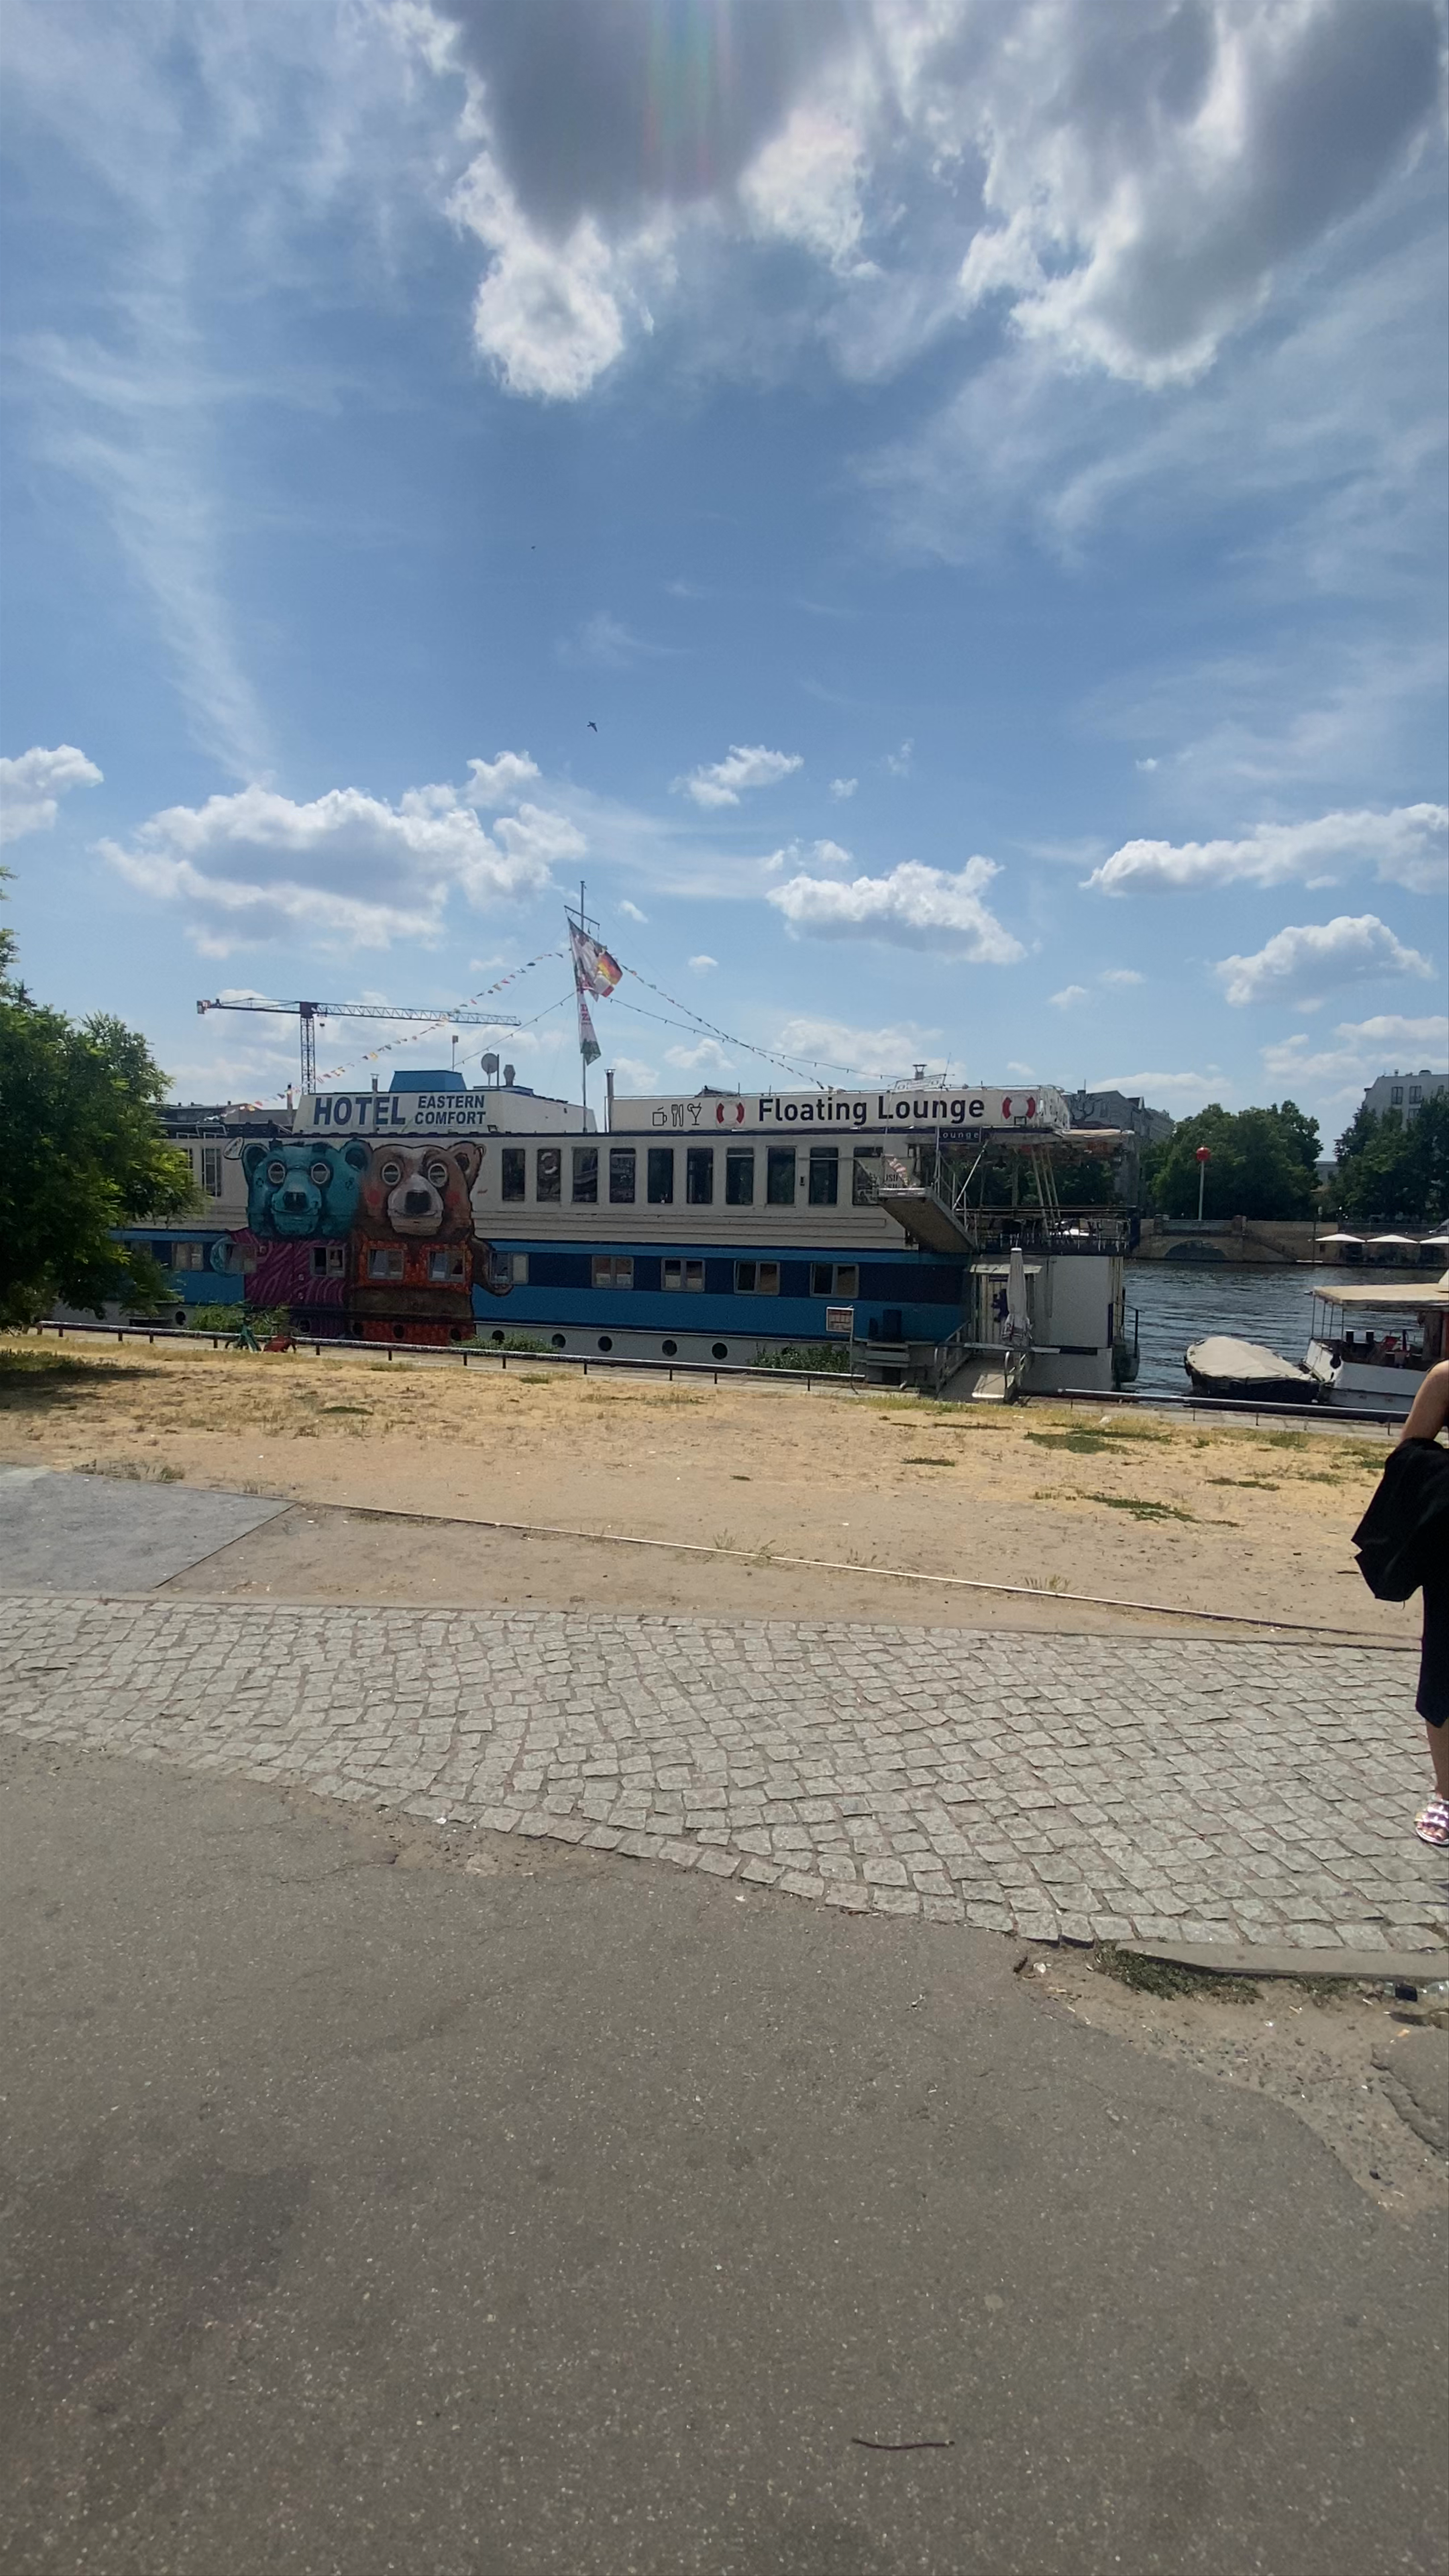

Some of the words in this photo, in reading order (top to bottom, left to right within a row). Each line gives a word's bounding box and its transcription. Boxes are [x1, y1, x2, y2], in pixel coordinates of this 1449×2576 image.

[418, 1095, 485, 1109] EASTERN
[314, 1097, 406, 1126] HOTEL
[759, 1097, 867, 1126] Floating
[878, 1095, 985, 1124] Lounge
[415, 1111, 486, 1125] COMFORT
[939, 1132, 979, 1140] ounge
